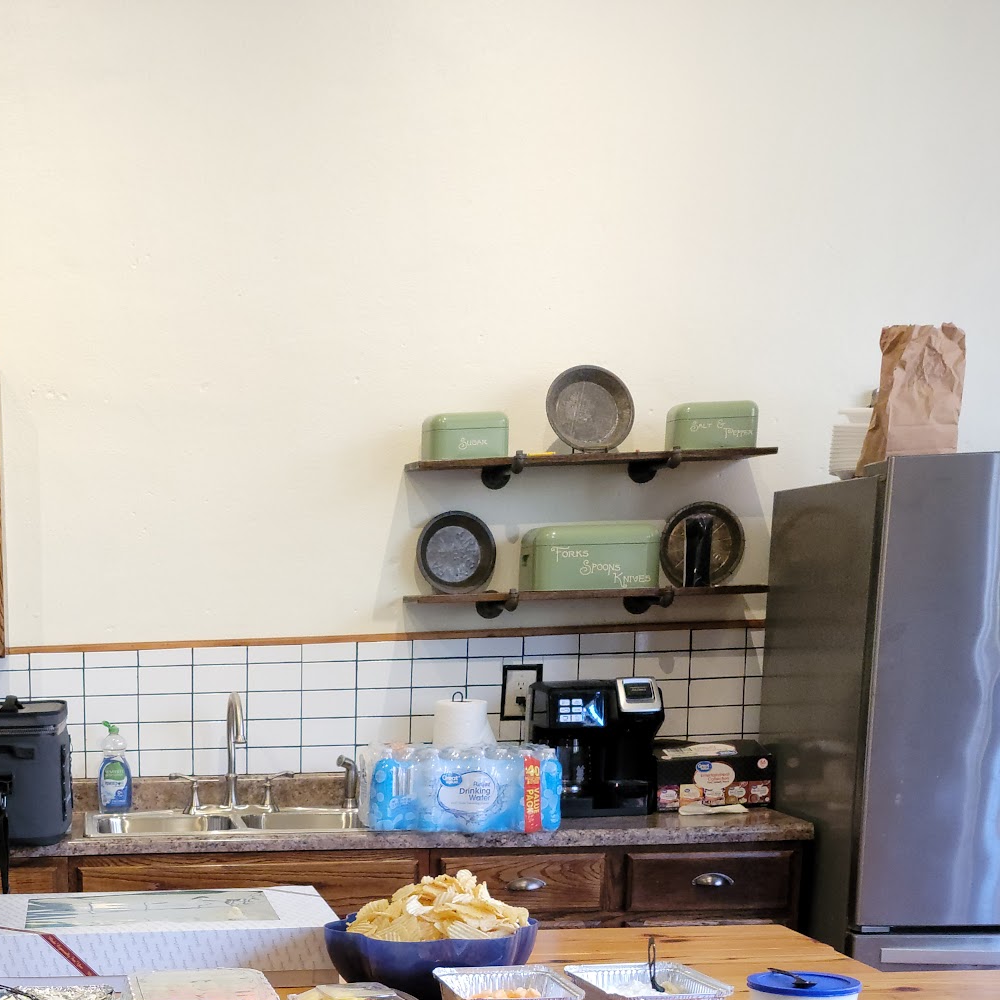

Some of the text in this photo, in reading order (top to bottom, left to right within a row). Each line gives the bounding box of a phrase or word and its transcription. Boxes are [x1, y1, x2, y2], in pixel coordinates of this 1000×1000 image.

[550, 545, 590, 562] FORKS
[579, 559, 621, 576] SPOONS
[612, 572, 651, 588] KNIVES
[459, 787, 491, 796] Drinking
